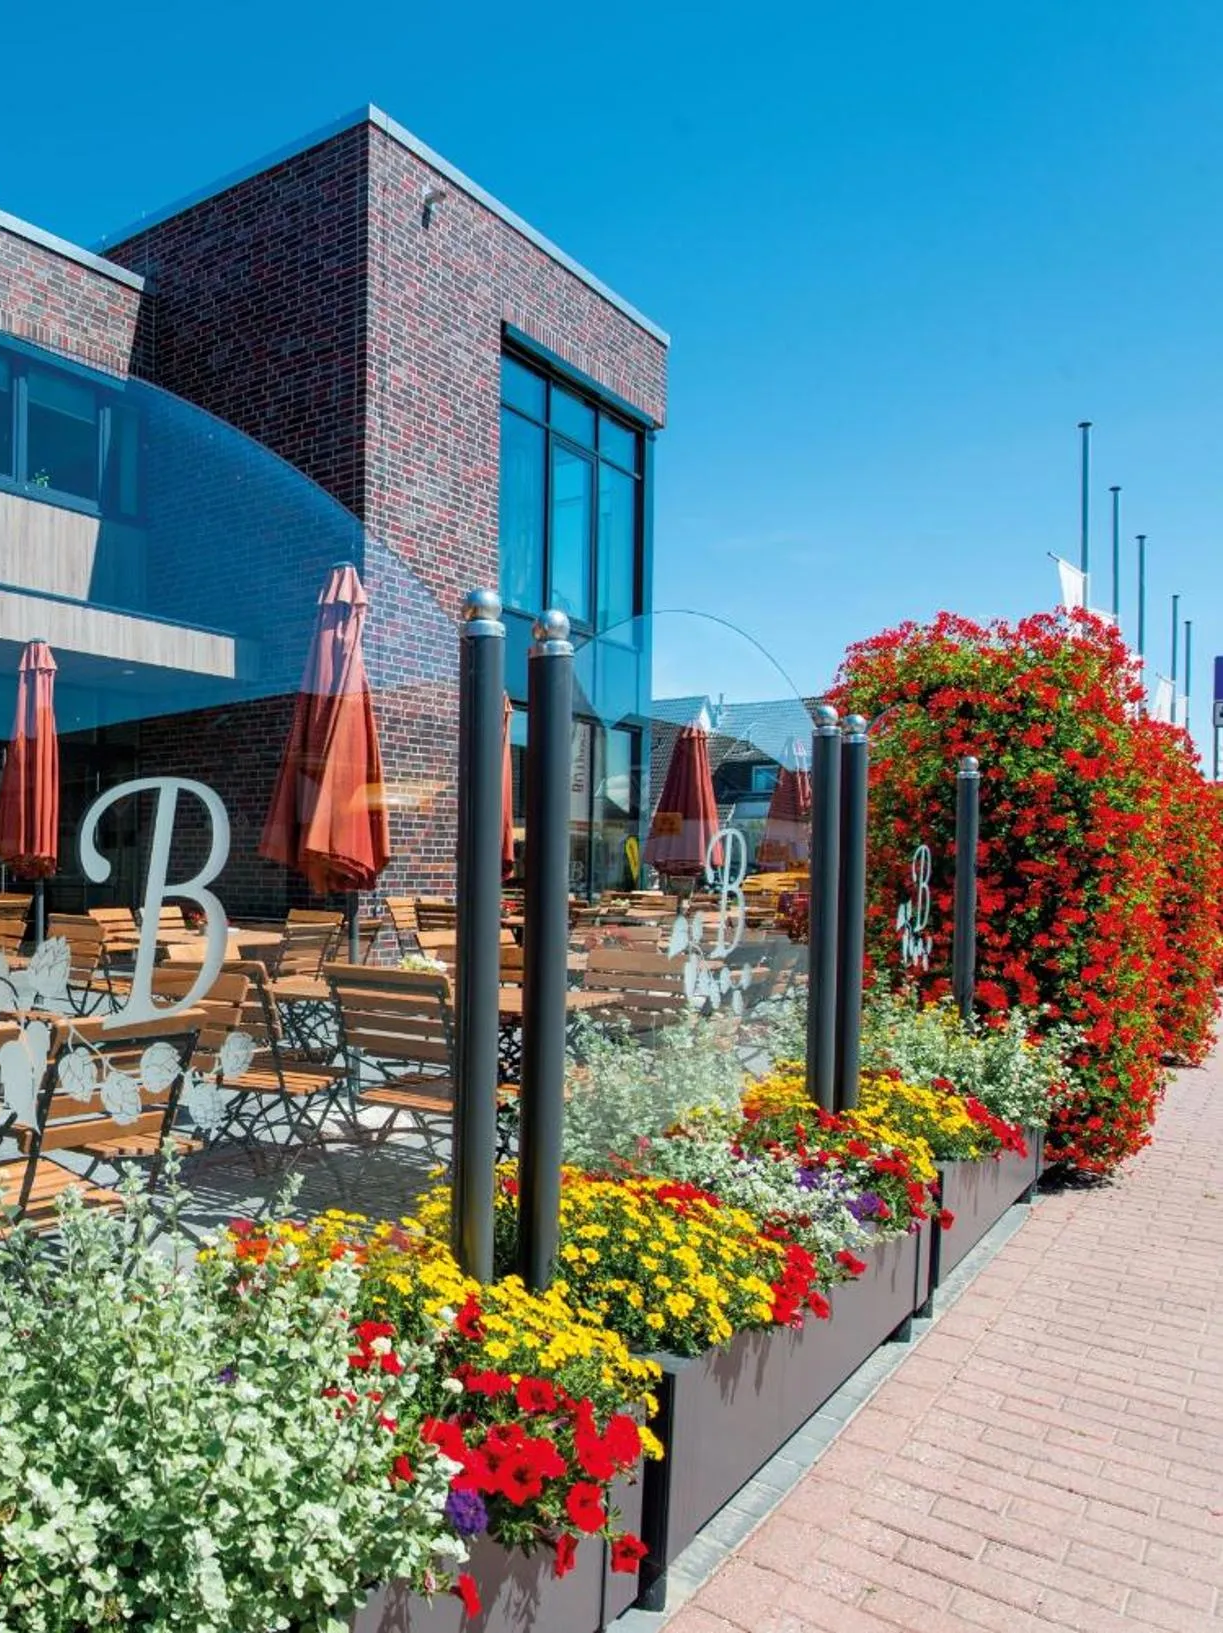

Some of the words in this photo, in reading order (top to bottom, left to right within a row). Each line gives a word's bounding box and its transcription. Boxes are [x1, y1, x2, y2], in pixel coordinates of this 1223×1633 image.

[80, 776, 231, 1030] B
[706, 828, 747, 958] B
[913, 845, 931, 932] B
